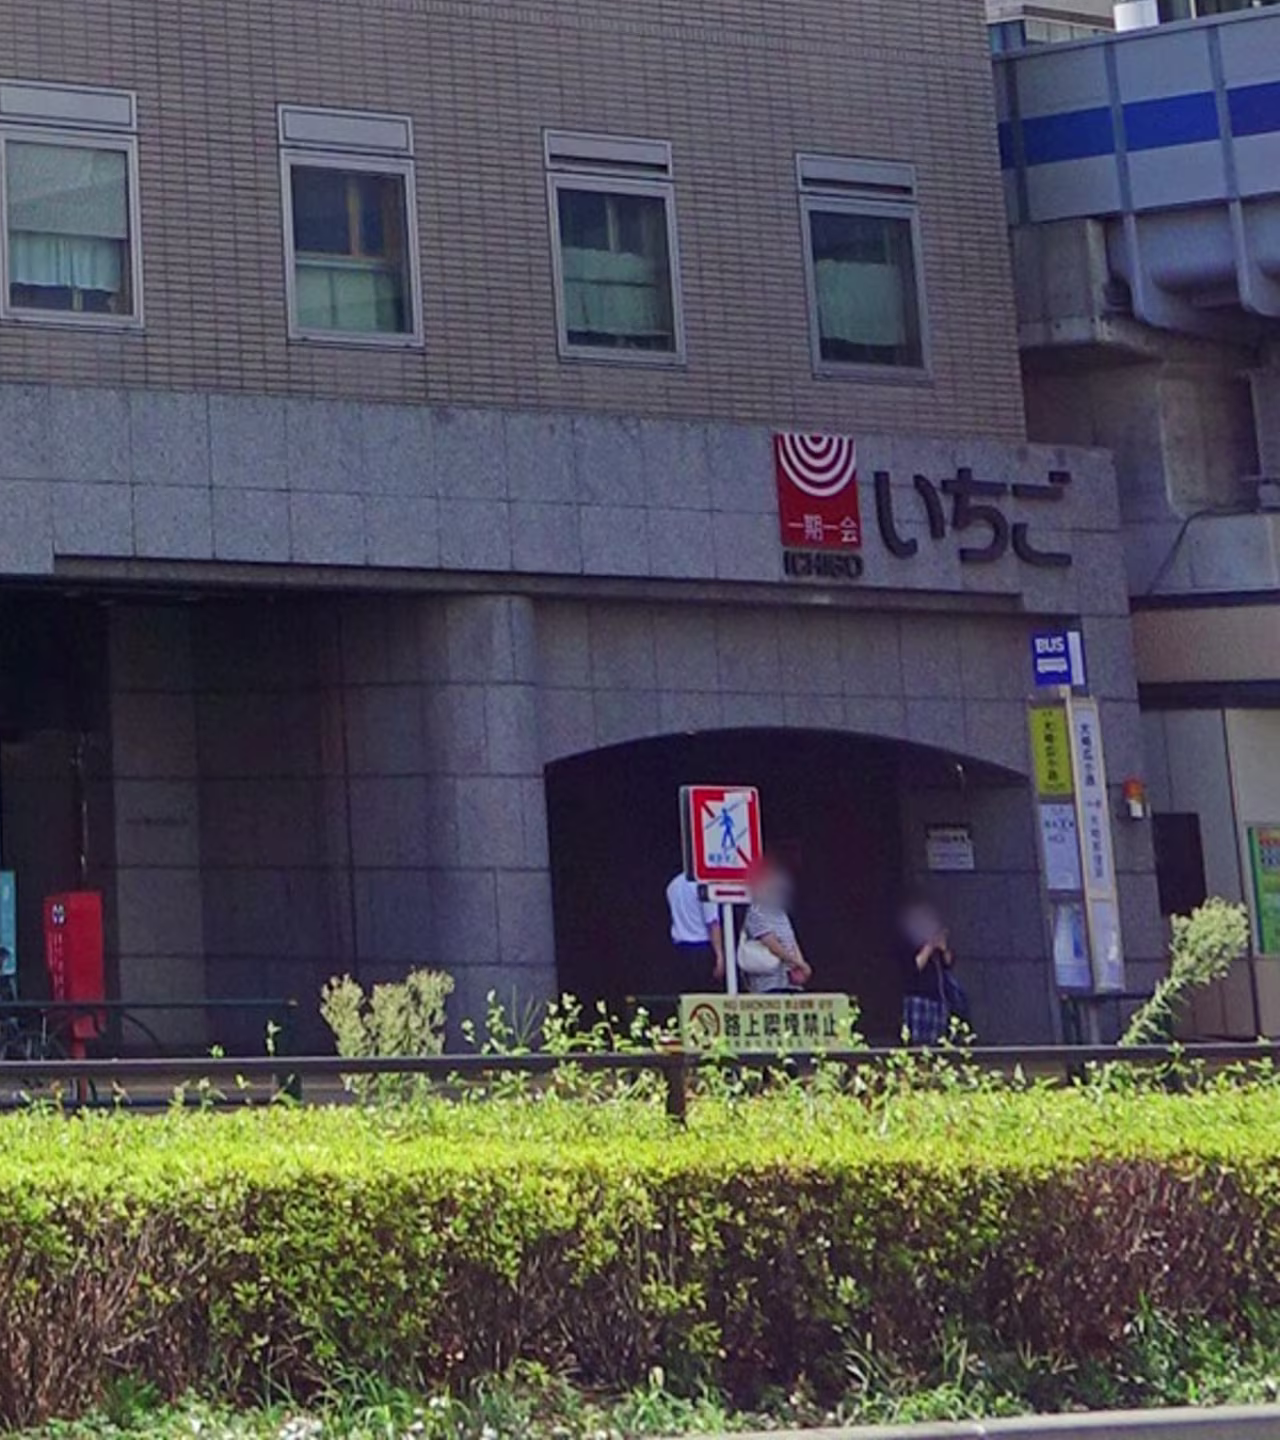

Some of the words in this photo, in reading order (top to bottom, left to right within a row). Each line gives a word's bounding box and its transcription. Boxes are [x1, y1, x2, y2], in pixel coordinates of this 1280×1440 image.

[788, 513, 858, 543] 一期一会
[873, 467, 1072, 566] いちご
[783, 551, 864, 577] ICHIGO
[1034, 636, 1066, 654] BUS
